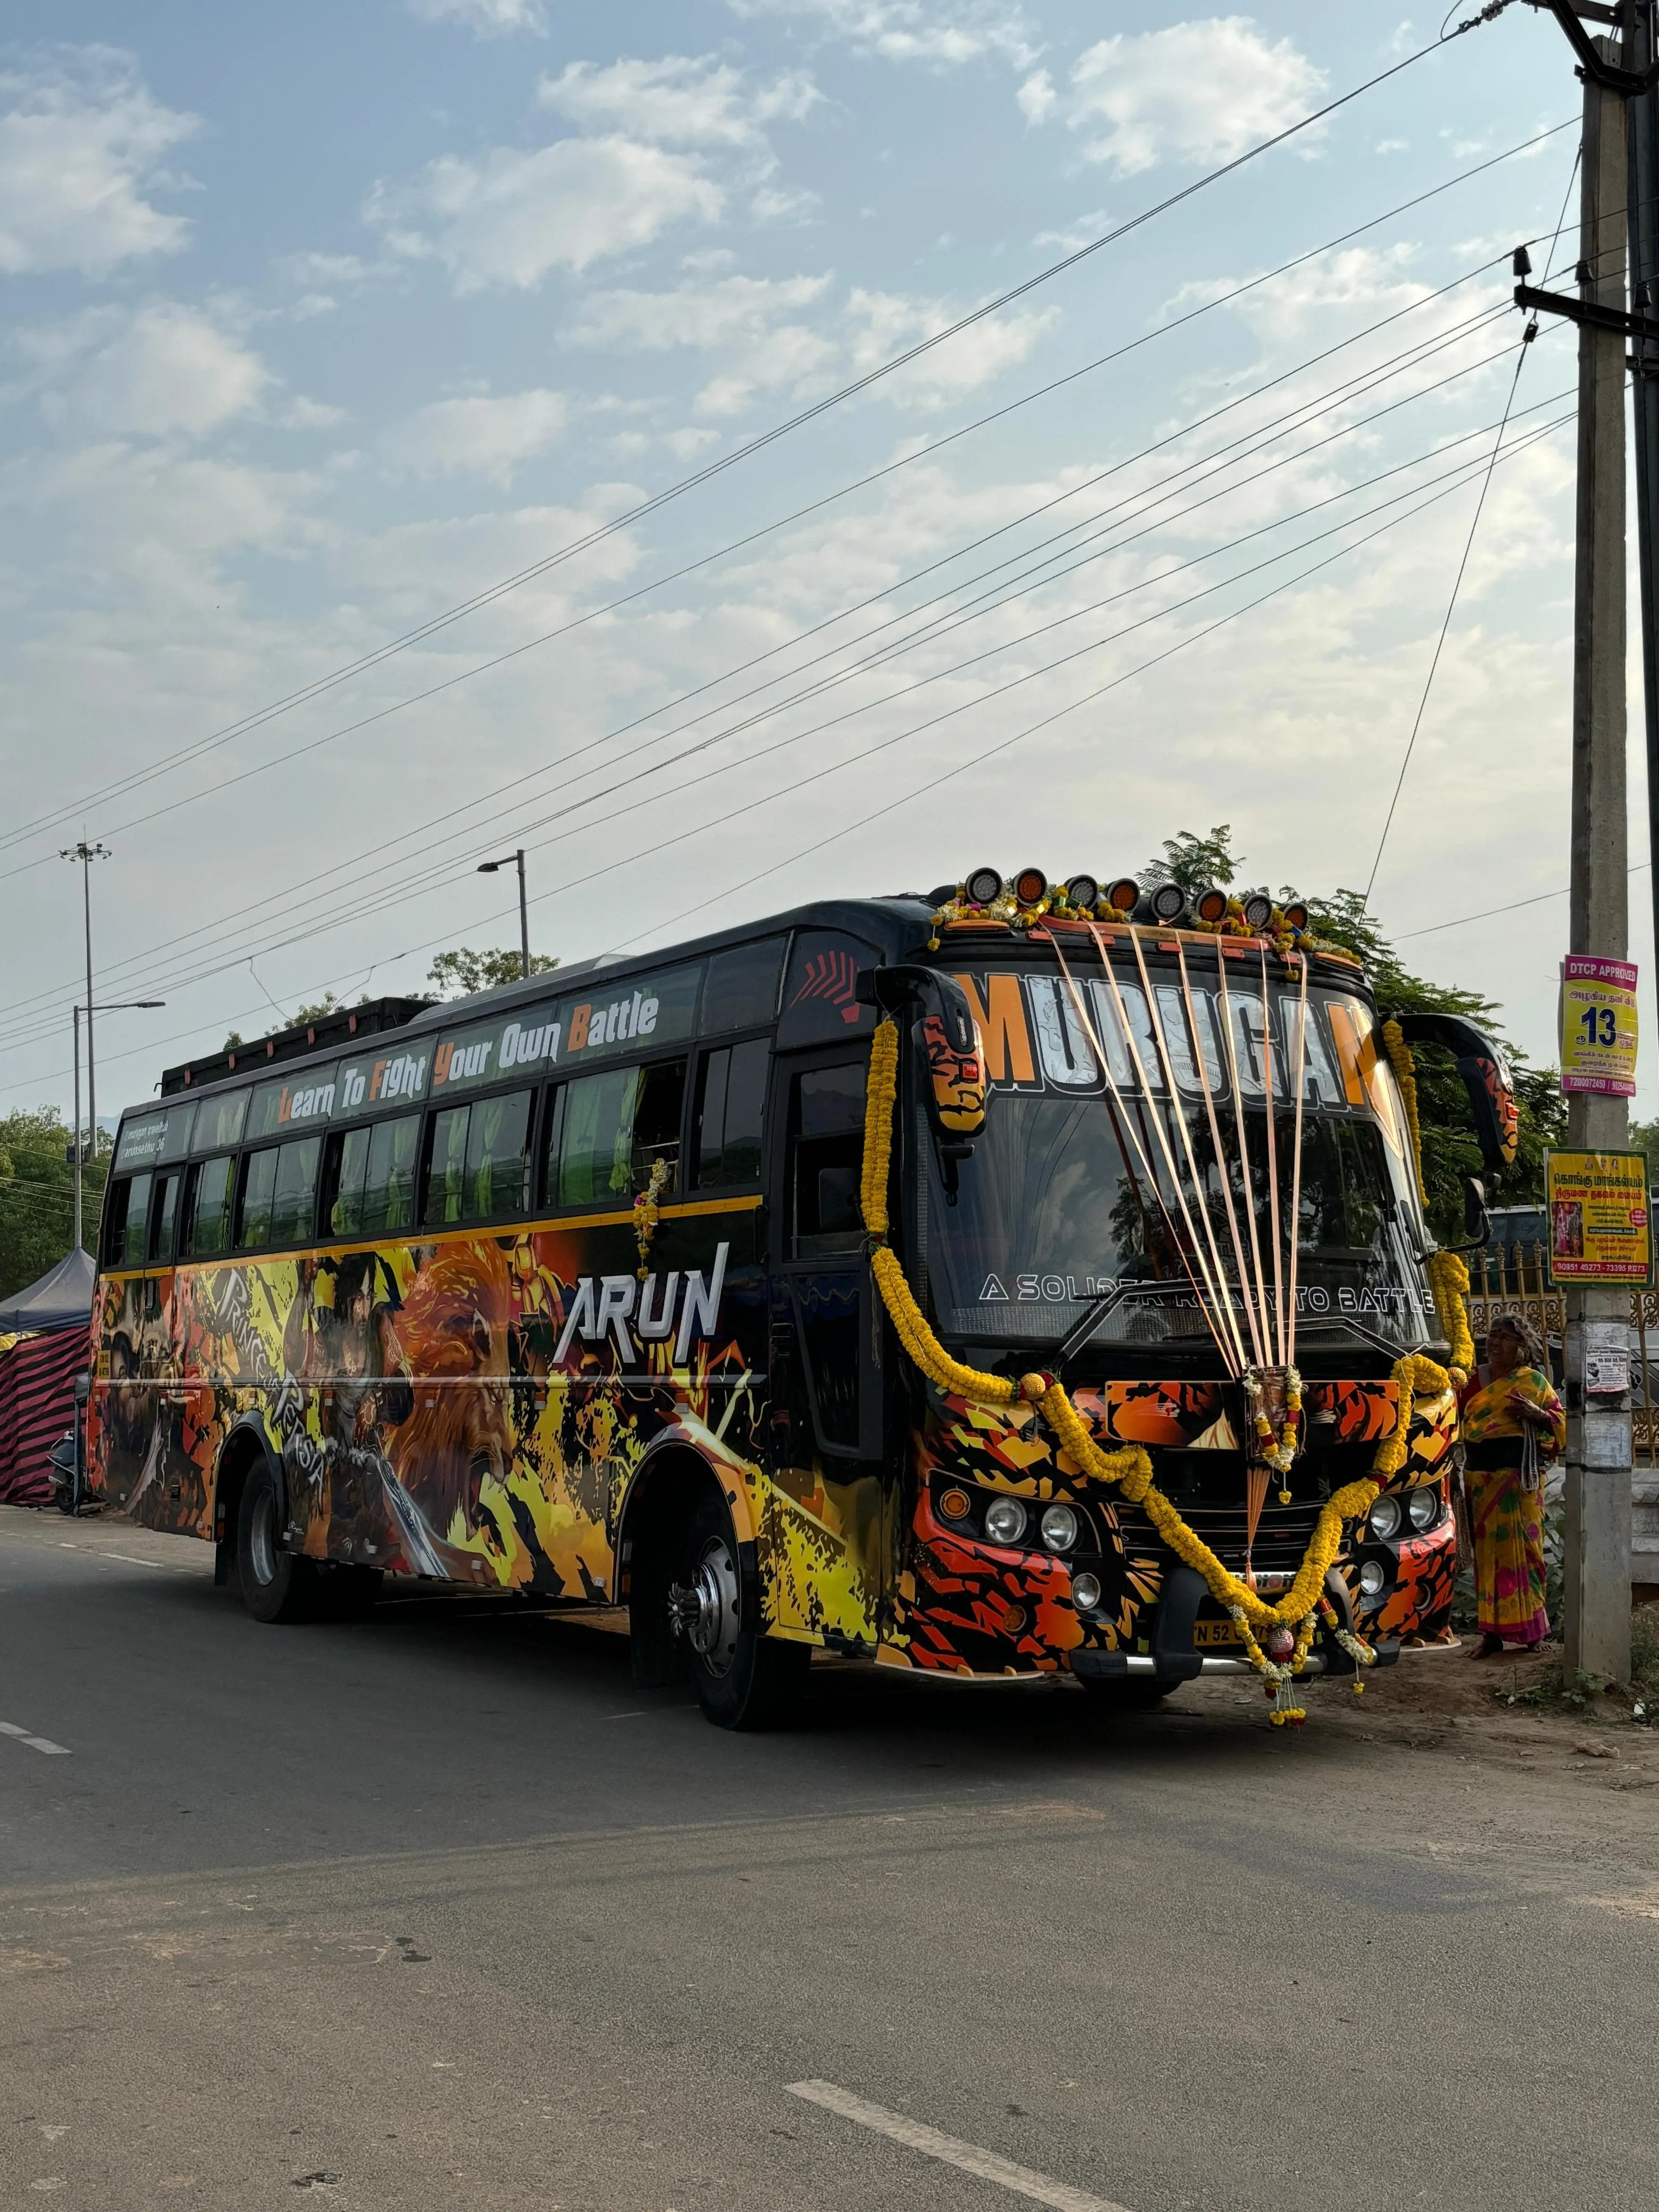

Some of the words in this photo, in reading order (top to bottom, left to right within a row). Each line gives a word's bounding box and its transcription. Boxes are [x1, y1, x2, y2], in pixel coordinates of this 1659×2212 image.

[1570, 962, 1596, 975] DTCP
[1599, 965, 1636, 982] APPROVED
[1580, 1006, 1616, 1048] 13
[278, 1083, 336, 1124] Learn
[341, 1068, 366, 1108] To
[368, 1053, 426, 1102] Fight
[433, 1041, 493, 1086] Your
[499, 1023, 561, 1069] Own
[566, 991, 659, 1053] Battle
[952, 972, 1396, 1138] MURUGAN
[1554, 1171, 1593, 1188] கொங்கு
[551, 1242, 730, 1363] ARUN
[979, 1273, 1009, 1300] A
[1290, 1286, 1330, 1312] TO
[1338, 1287, 1436, 1314] BATTLE
[1195, 1626, 1208, 1641] N
[1212, 1624, 1229, 1641] 52
